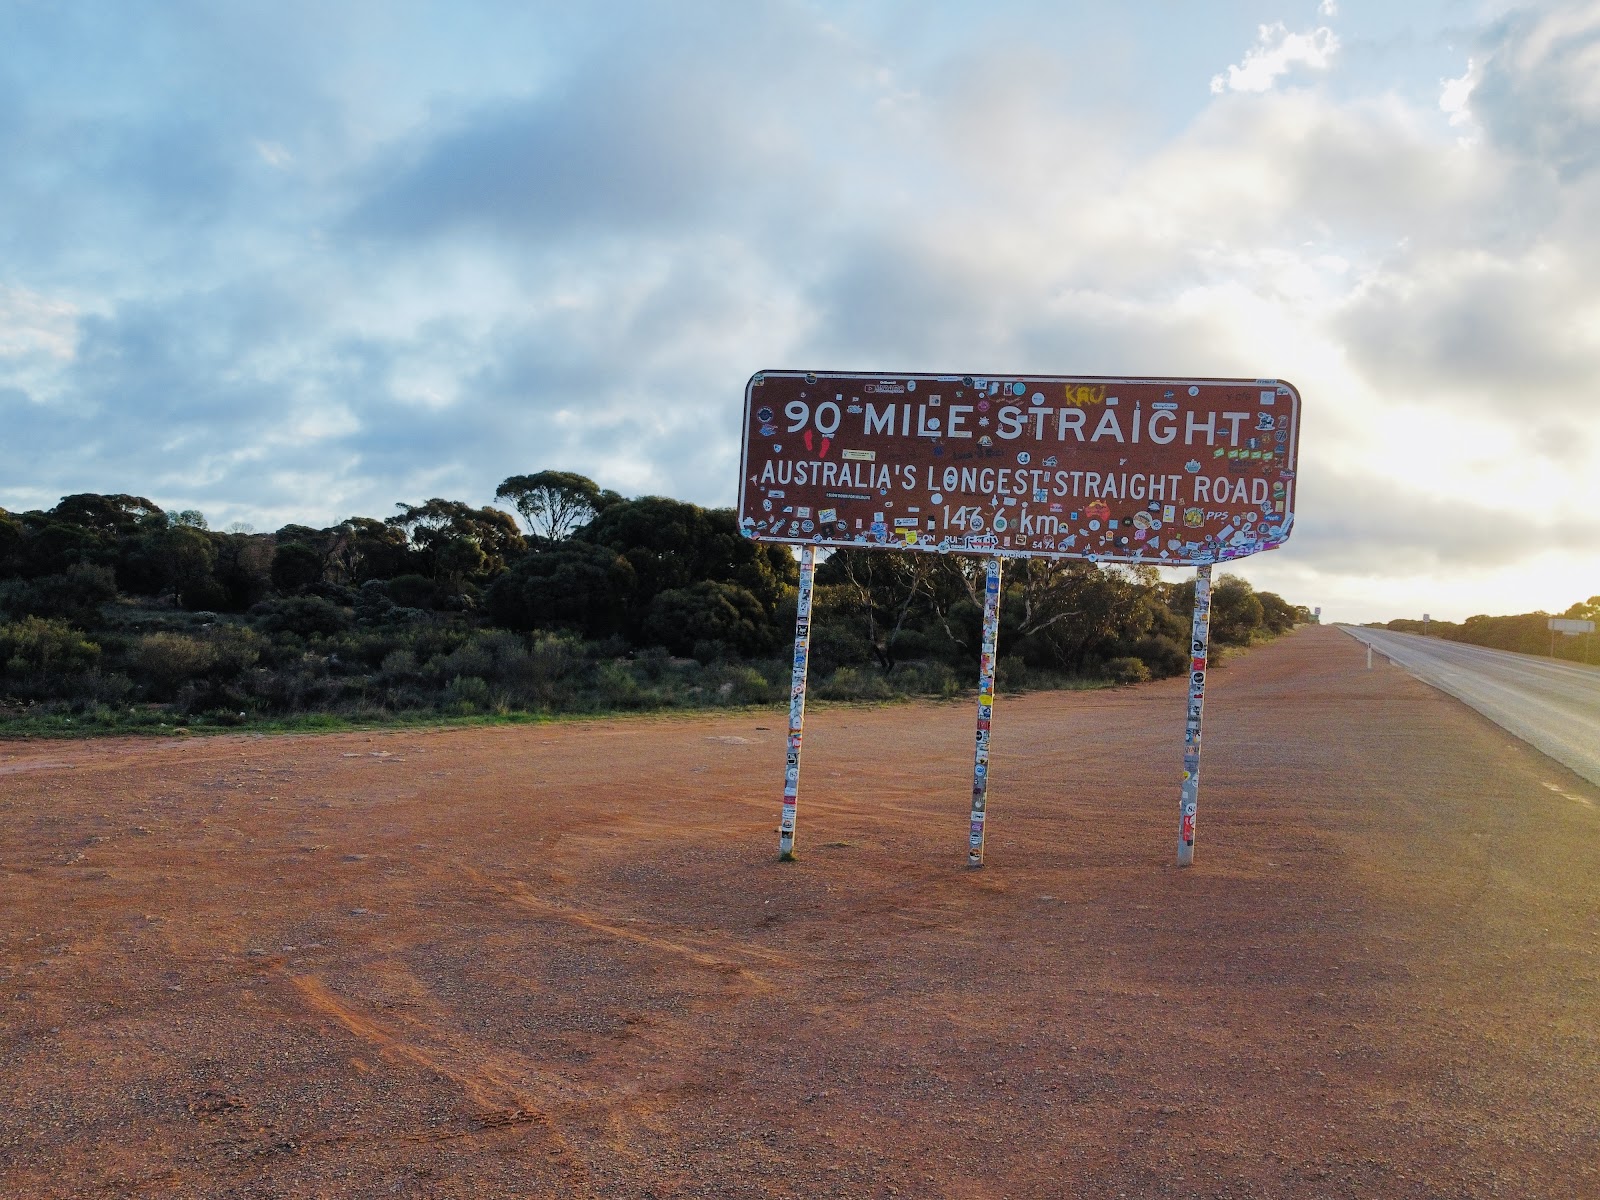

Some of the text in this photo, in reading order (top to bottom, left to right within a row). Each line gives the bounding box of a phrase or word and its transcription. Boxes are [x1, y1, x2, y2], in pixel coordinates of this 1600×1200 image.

[784, 400, 841, 434] 90
[863, 403, 974, 438] MILE
[995, 405, 1250, 446] STRAIGHT
[760, 459, 1269, 504] AUSTRALIA'S LONGEST STRAIGHT ROAD
[943, 505, 1059, 535] 146.6 km
[1206, 511, 1229, 520] PPS
